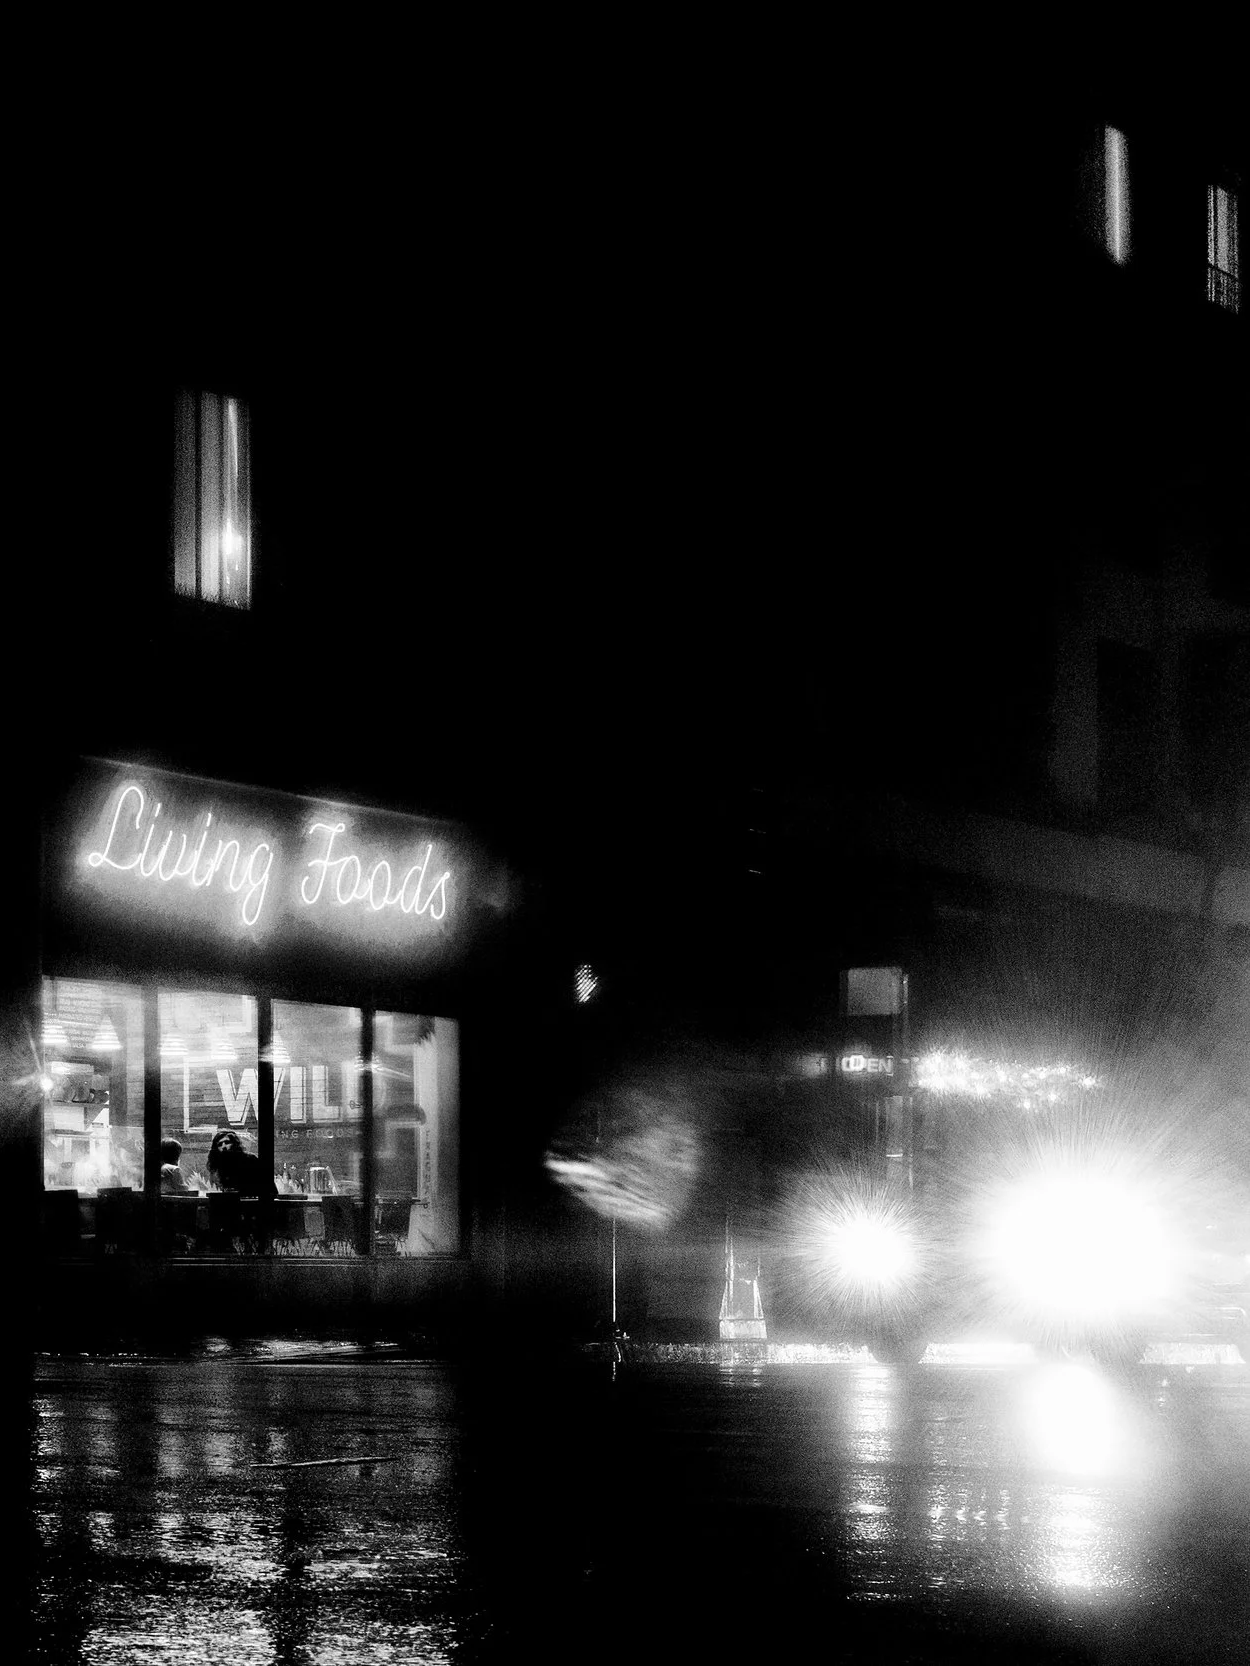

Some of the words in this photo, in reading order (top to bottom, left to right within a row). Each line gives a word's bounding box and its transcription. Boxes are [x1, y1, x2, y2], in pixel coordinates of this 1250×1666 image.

[88, 785, 275, 926] Living
[301, 822, 451, 920] Foods
[841, 1056, 894, 1073] OEN
